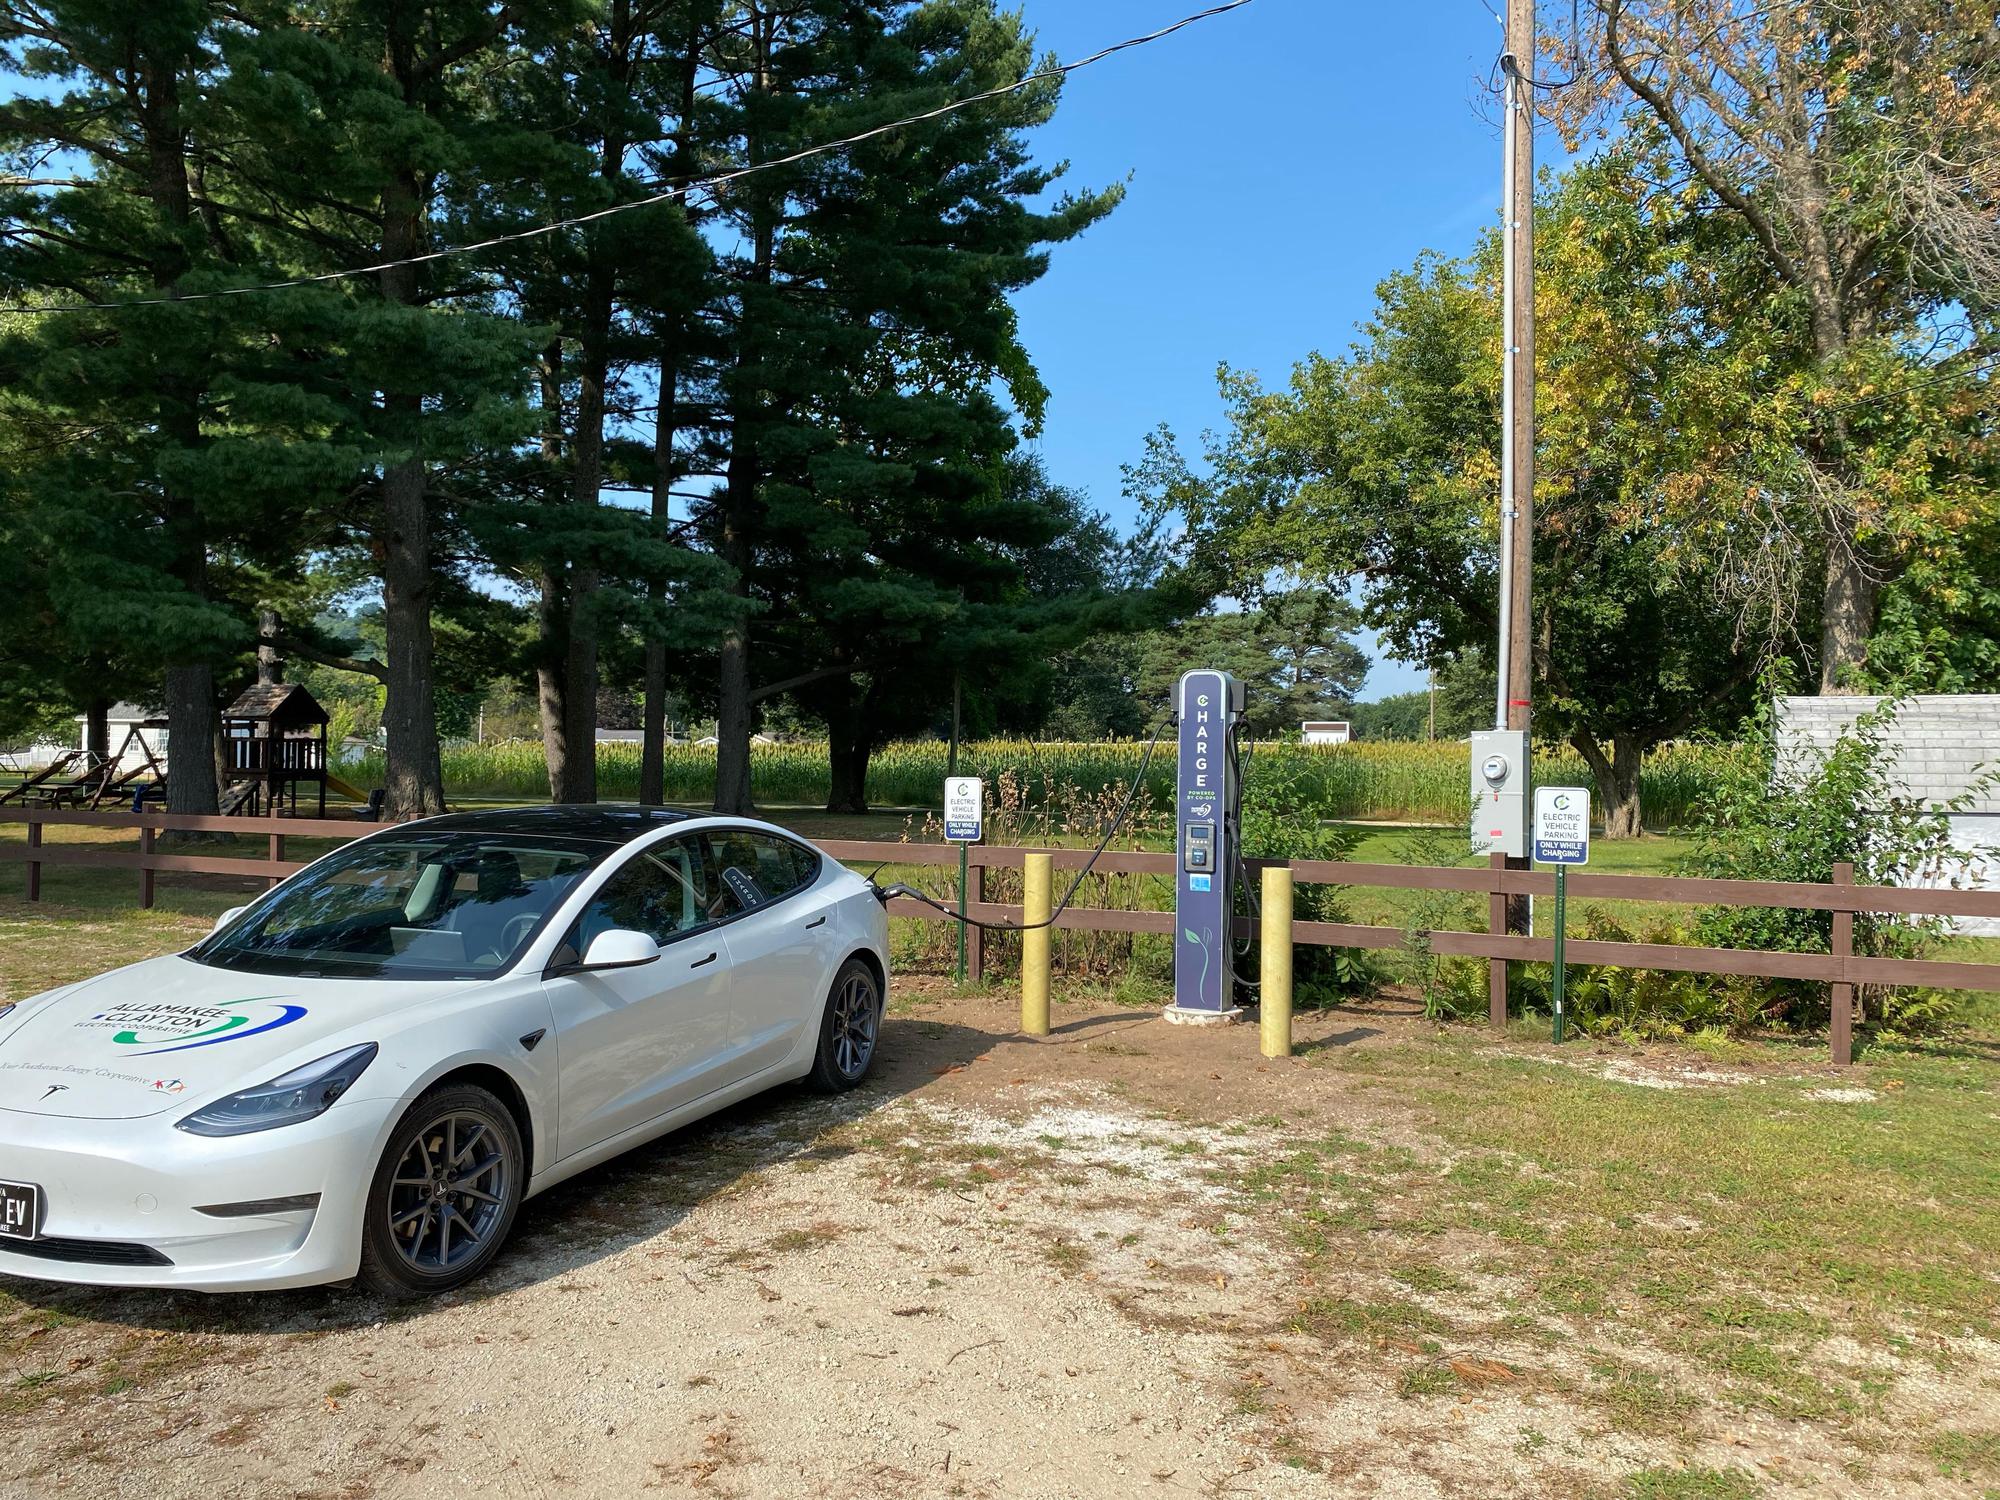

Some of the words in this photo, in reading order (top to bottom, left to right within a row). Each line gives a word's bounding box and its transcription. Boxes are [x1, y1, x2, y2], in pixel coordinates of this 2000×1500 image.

[1196, 694, 1209, 787] CHARGE
[1543, 813, 1581, 821] ELECTRIC
[1545, 822, 1578, 830] VEHICLE
[1544, 831, 1578, 839] PARKING
[1540, 841, 1559, 849] ONLY
[1542, 849, 1580, 857] CHARGING
[108, 1003, 231, 1018] ALLAMAKEE
[105, 1013, 211, 1028] CLAYTON
[122, 1023, 193, 1034] COOPERATIVE
[95, 1068, 151, 1085] Cooperative
[6, 1198, 26, 1226] EV
